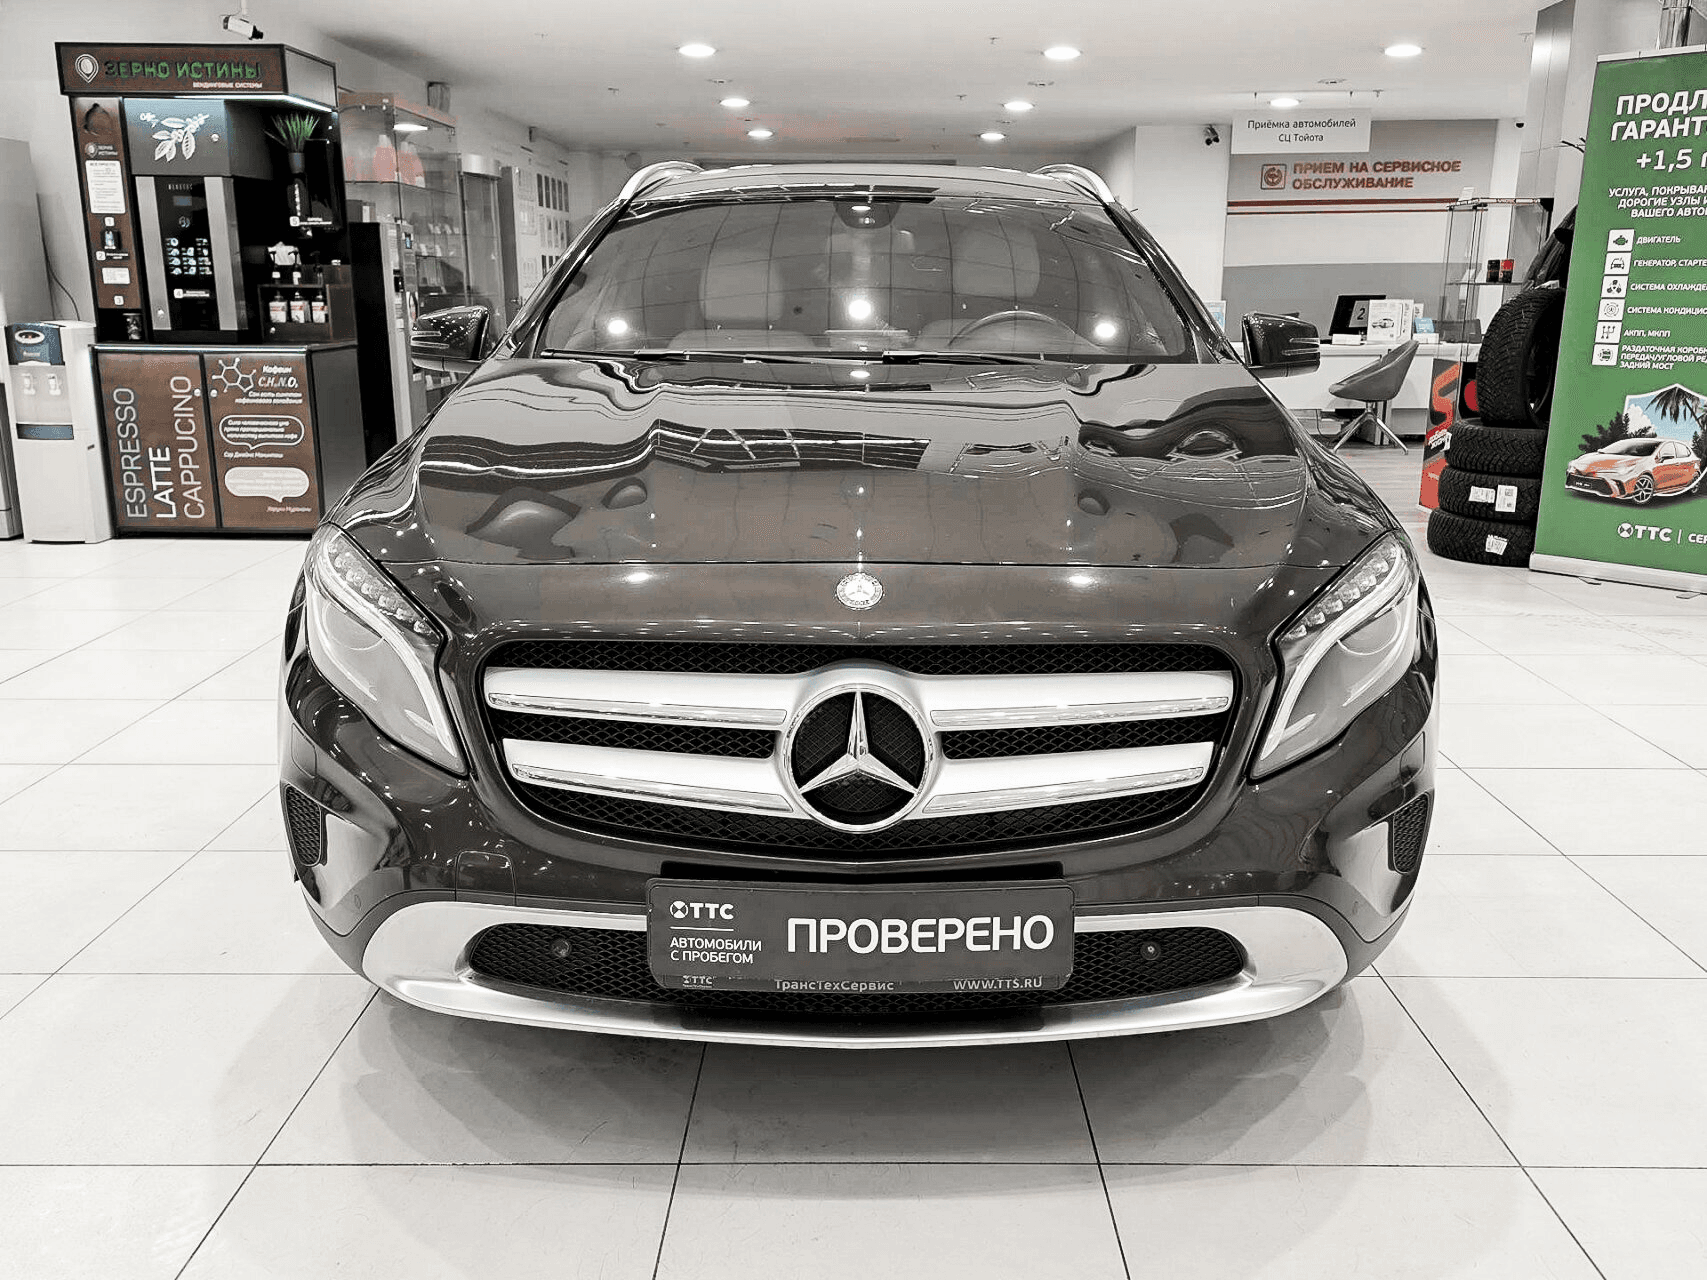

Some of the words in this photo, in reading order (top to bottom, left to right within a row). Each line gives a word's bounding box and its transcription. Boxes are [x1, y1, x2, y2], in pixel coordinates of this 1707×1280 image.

[104, 61, 170, 79] ЗЕРНО
[176, 61, 262, 79] ИСТИНЫ
[1247, 119, 1290, 131] Приёмка
[1292, 118, 1356, 128] автомобилей
[1278, 133, 1291, 142] СЦ
[1293, 133, 1324, 141] Тойота
[1293, 162, 1345, 174] ПРИЕМ
[1349, 161, 1369, 173] НА
[1373, 160, 1462, 173] СЕРВИСНОЕ
[1636, 149, 1693, 173] +1,5
[1292, 177, 1415, 190] ОБСЛУЖИВАНИЕ
[1608, 187, 1649, 198] УСЛУГА,
[1618, 197, 1669, 209] ДОРОГИЕ
[1670, 196, 1700, 206] УЗЛЫ
[1631, 208, 1675, 218] ВАШЕГО
[1636, 236, 1681, 244] ДВИГАТЕЛЬ
[1630, 283, 1666, 291] СИСТЕМА
[1356, 307, 1366, 320] 2
[1647, 330, 1671, 338] МКПП
[1622, 344, 1676, 353] РАЗДАТОЧНАЯ
[1620, 361, 1651, 369] ЗАДНИЙ
[1652, 362, 1675, 370] МОСТ
[113, 387, 148, 518] ESPRESSO
[170, 375, 206, 519] CAPPUCINO
[148, 446, 177, 518] LATTE
[690, 902, 734, 920] ТТС
[787, 914, 1055, 954] ПРОВЕРЕНО
[670, 937, 762, 951] АВТОМОБИЛИ
[670, 950, 680, 961] С
[683, 950, 753, 964] ПРОБЕГОМ
[774, 980, 895, 993] ТрансТехСервис
[953, 976, 1043, 990] WWW.TTS.RU
